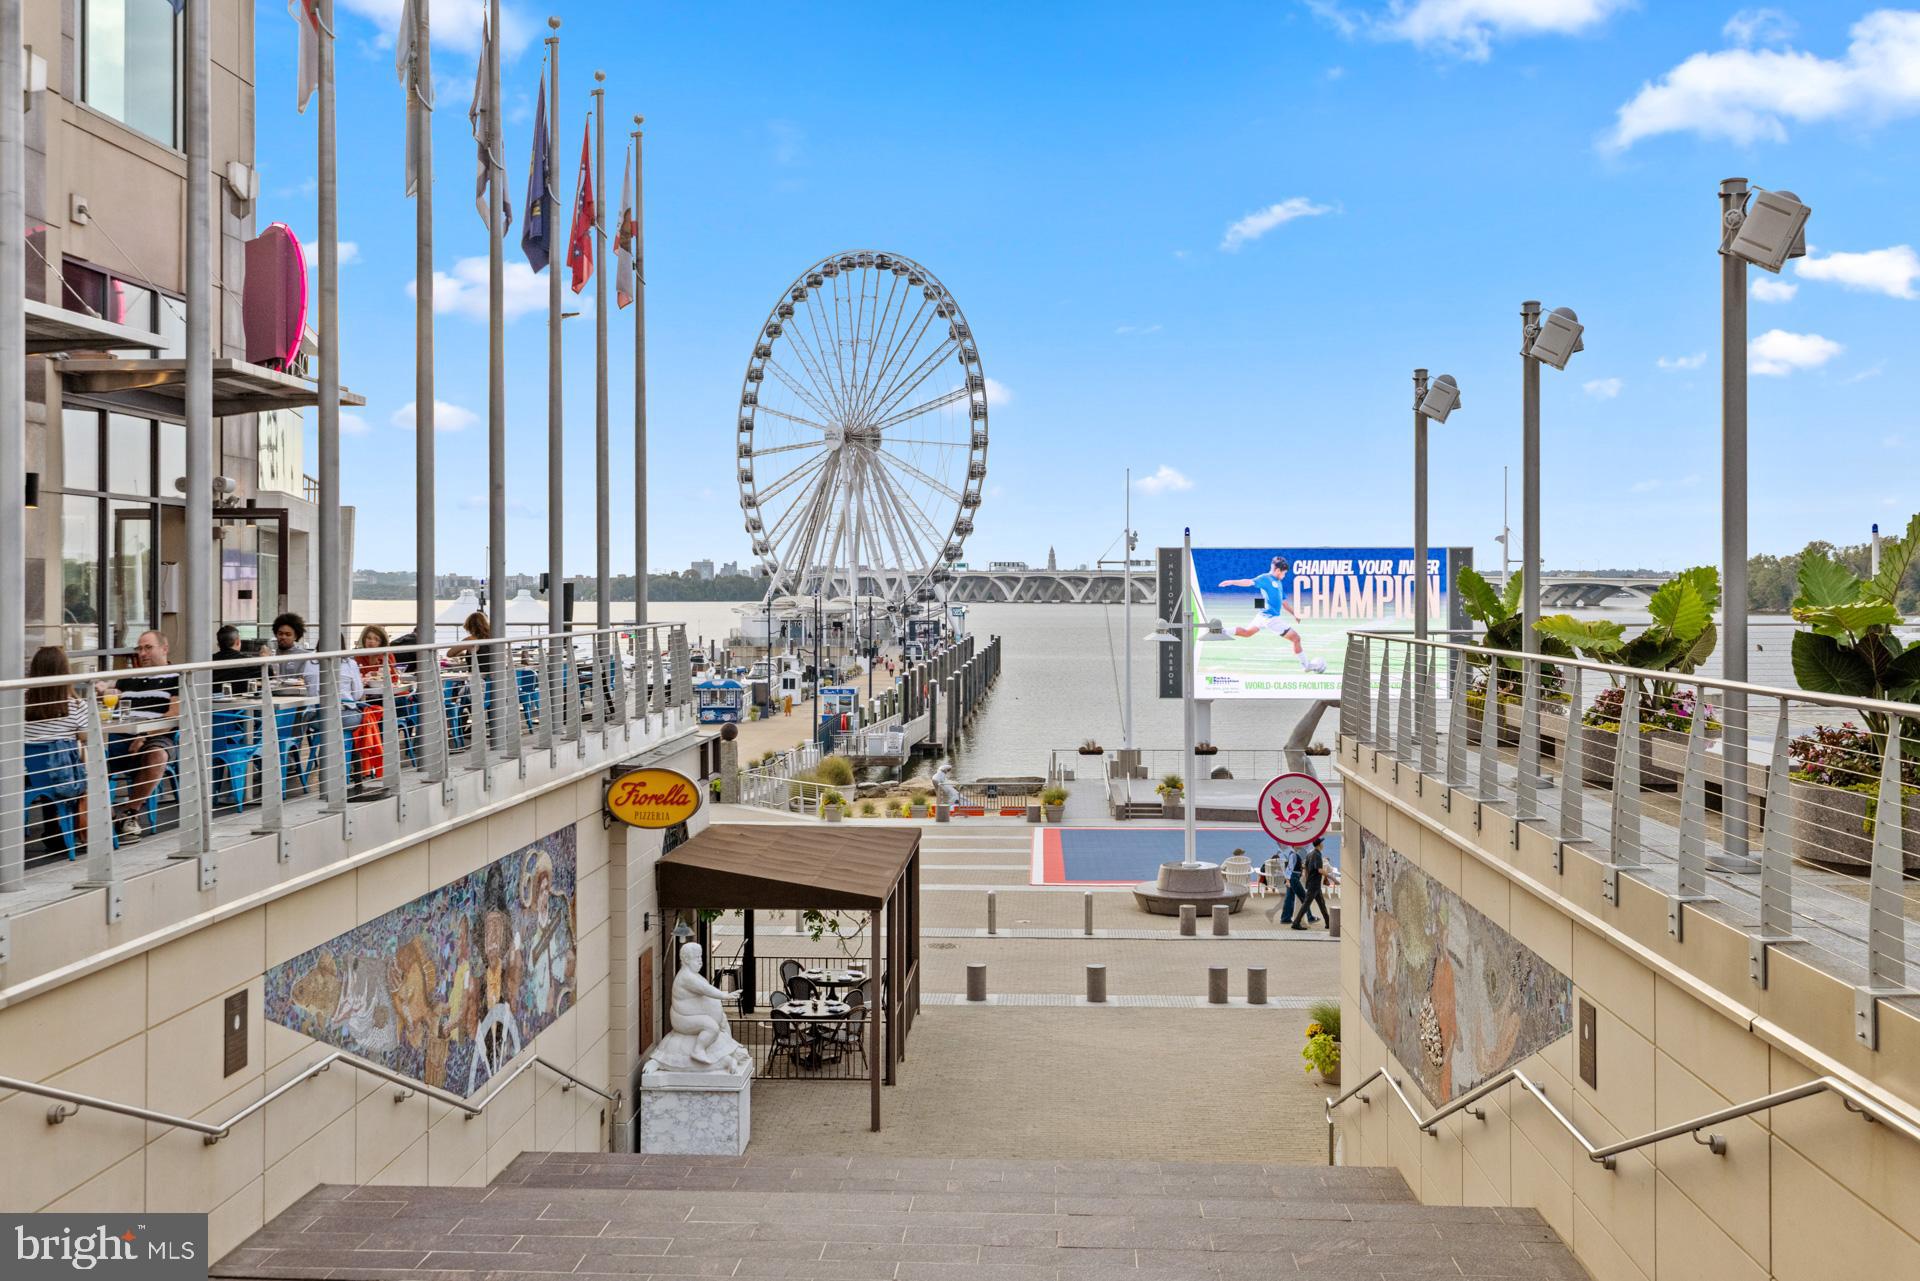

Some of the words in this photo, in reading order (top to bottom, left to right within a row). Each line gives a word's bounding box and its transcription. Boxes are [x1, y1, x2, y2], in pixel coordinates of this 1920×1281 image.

[1293, 559, 1354, 575] CHANNEL
[1358, 559, 1393, 575] YOUR
[1398, 559, 1440, 575] INER
[1293, 575, 1440, 620] CHAMPION
[1298, 681, 1335, 690] FACILITIES
[614, 781, 692, 807] Fiorella
[634, 811, 670, 821] PIZZERIA
